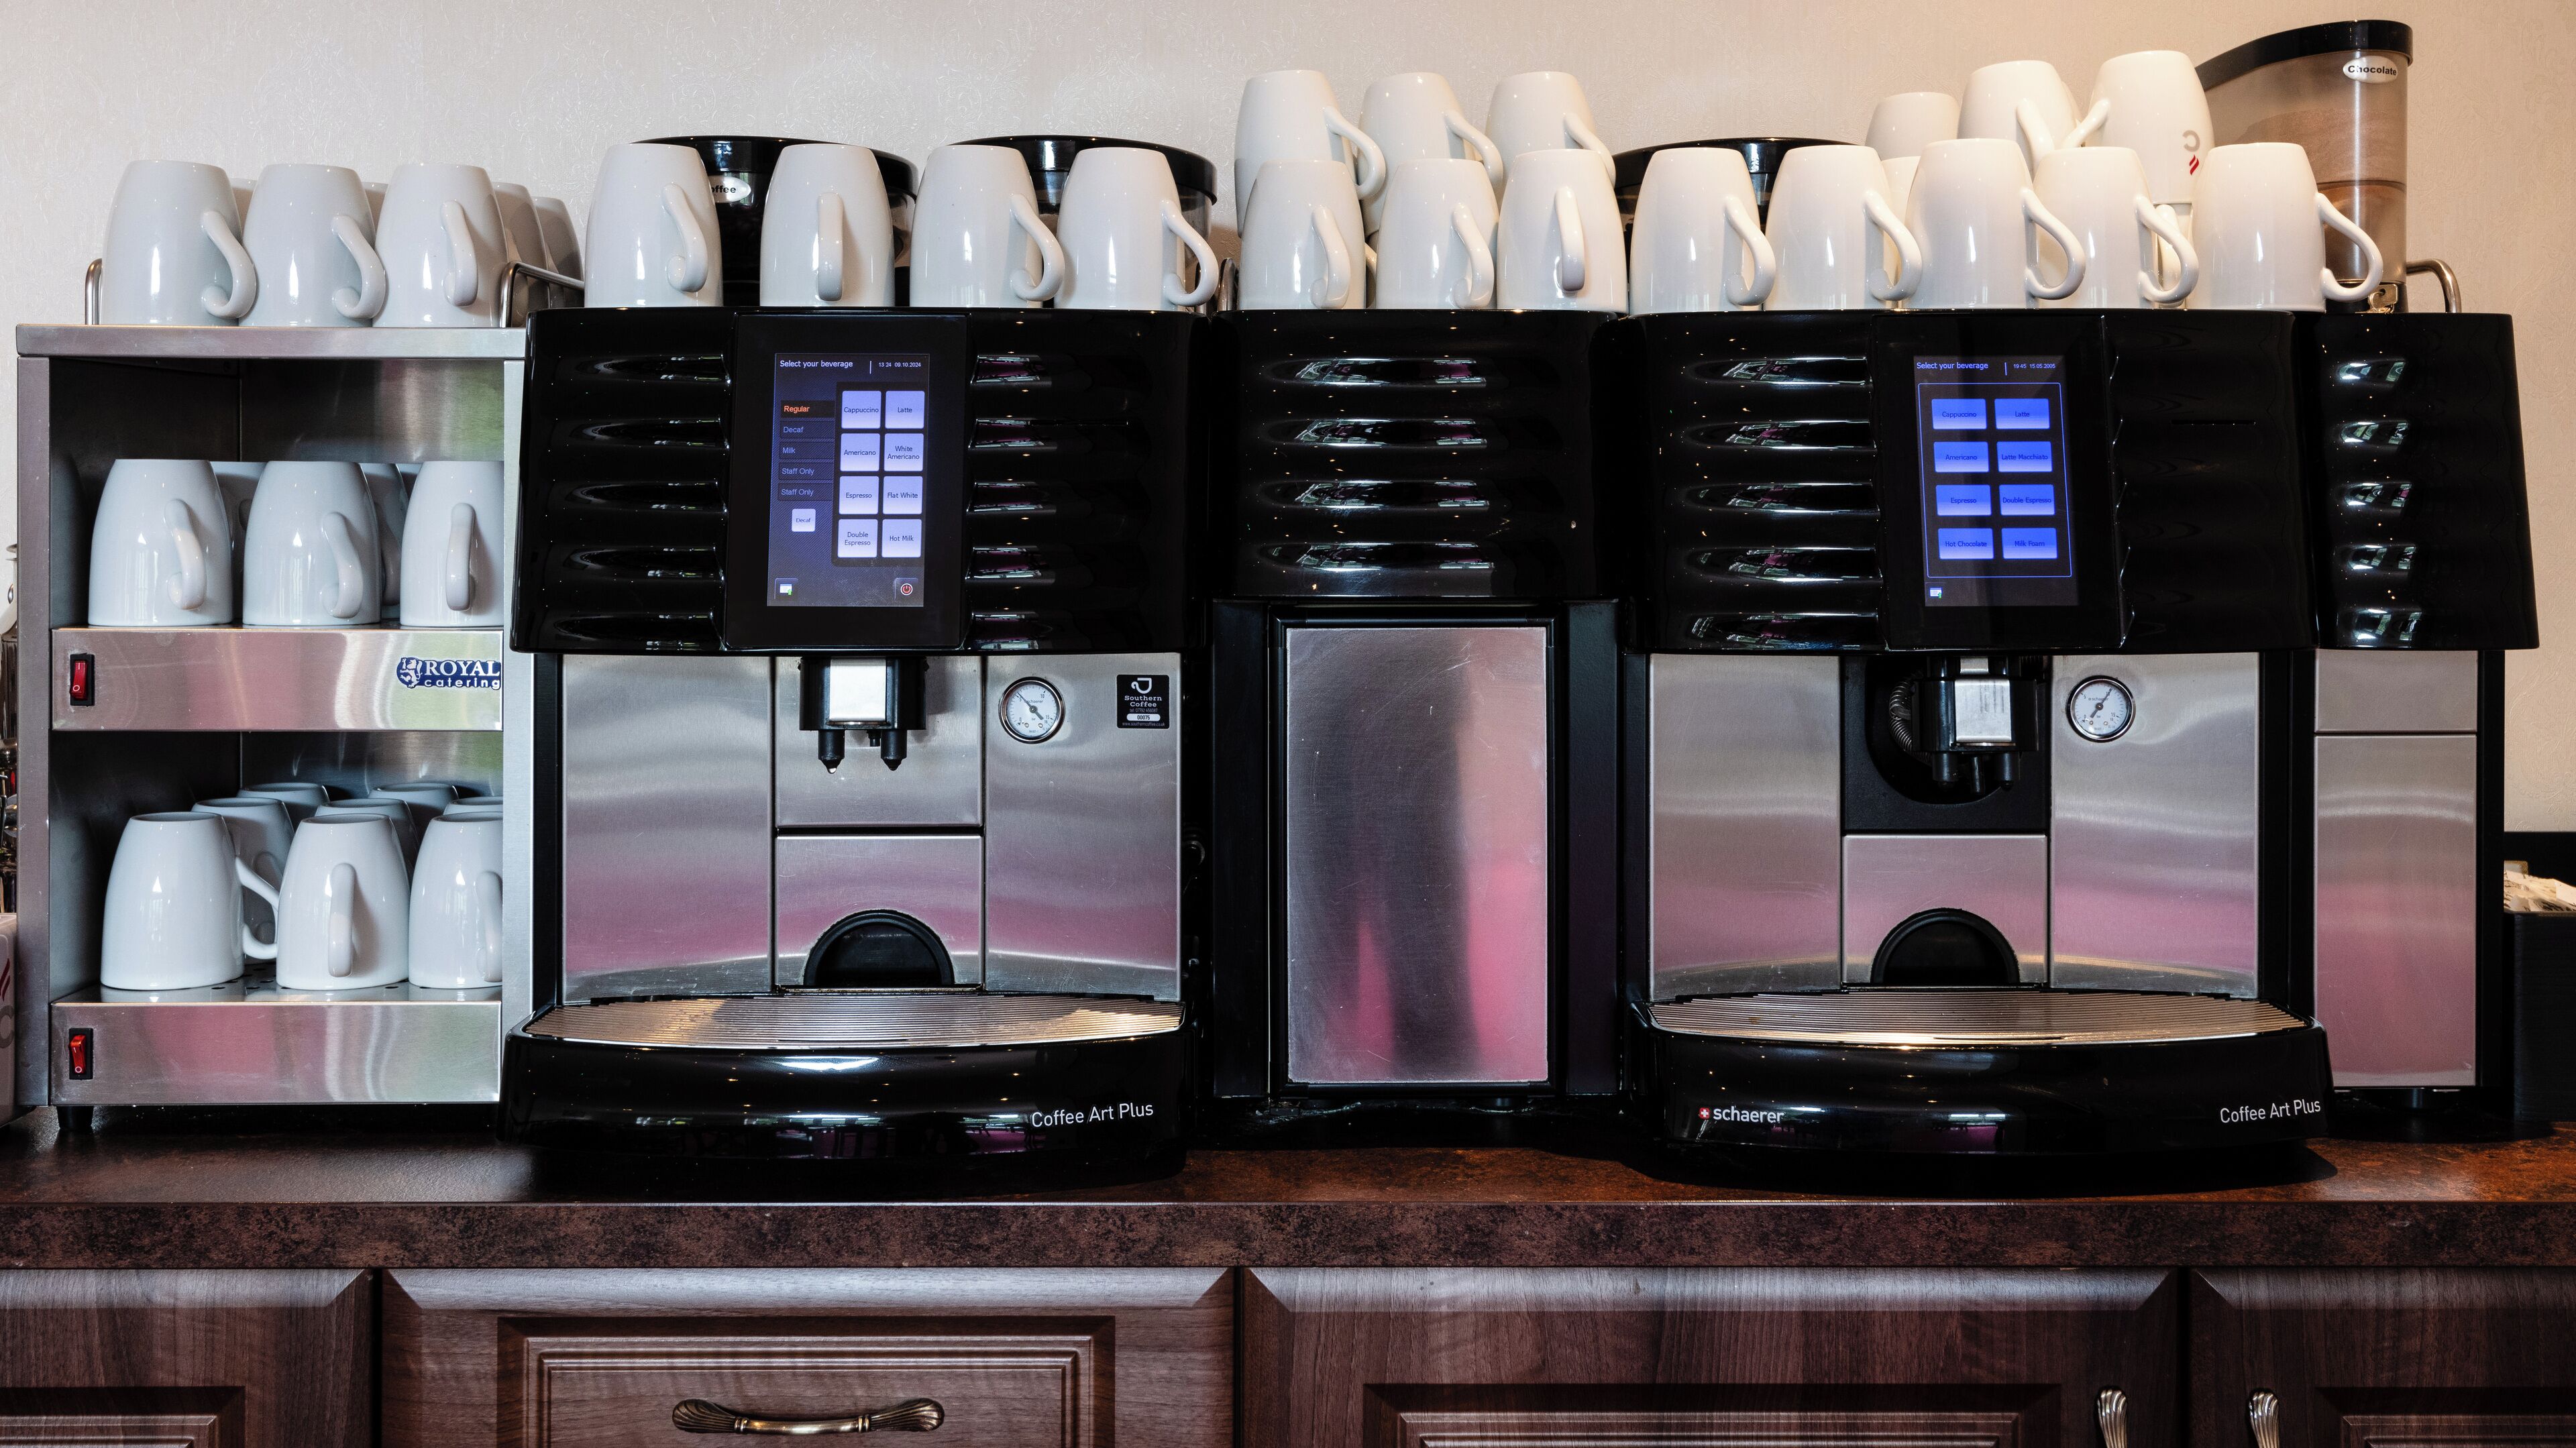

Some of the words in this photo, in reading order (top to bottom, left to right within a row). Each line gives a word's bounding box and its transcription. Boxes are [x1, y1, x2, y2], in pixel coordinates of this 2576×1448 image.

[820, 360, 853, 368] beverage
[1956, 362, 1988, 370] beverage
[798, 489, 814, 497] Only
[424, 661, 500, 676] ROYAL
[424, 677, 500, 689] catering
[1032, 1109, 1084, 1127] Coffee
[1089, 1106, 1114, 1122] Art
[1119, 1103, 1154, 1119] Plus
[1713, 1105, 1785, 1123] schaerer
[2220, 1105, 2266, 1123] Coffee
[2269, 1103, 2291, 1119] Art
[2293, 1099, 2321, 1115] Plus
